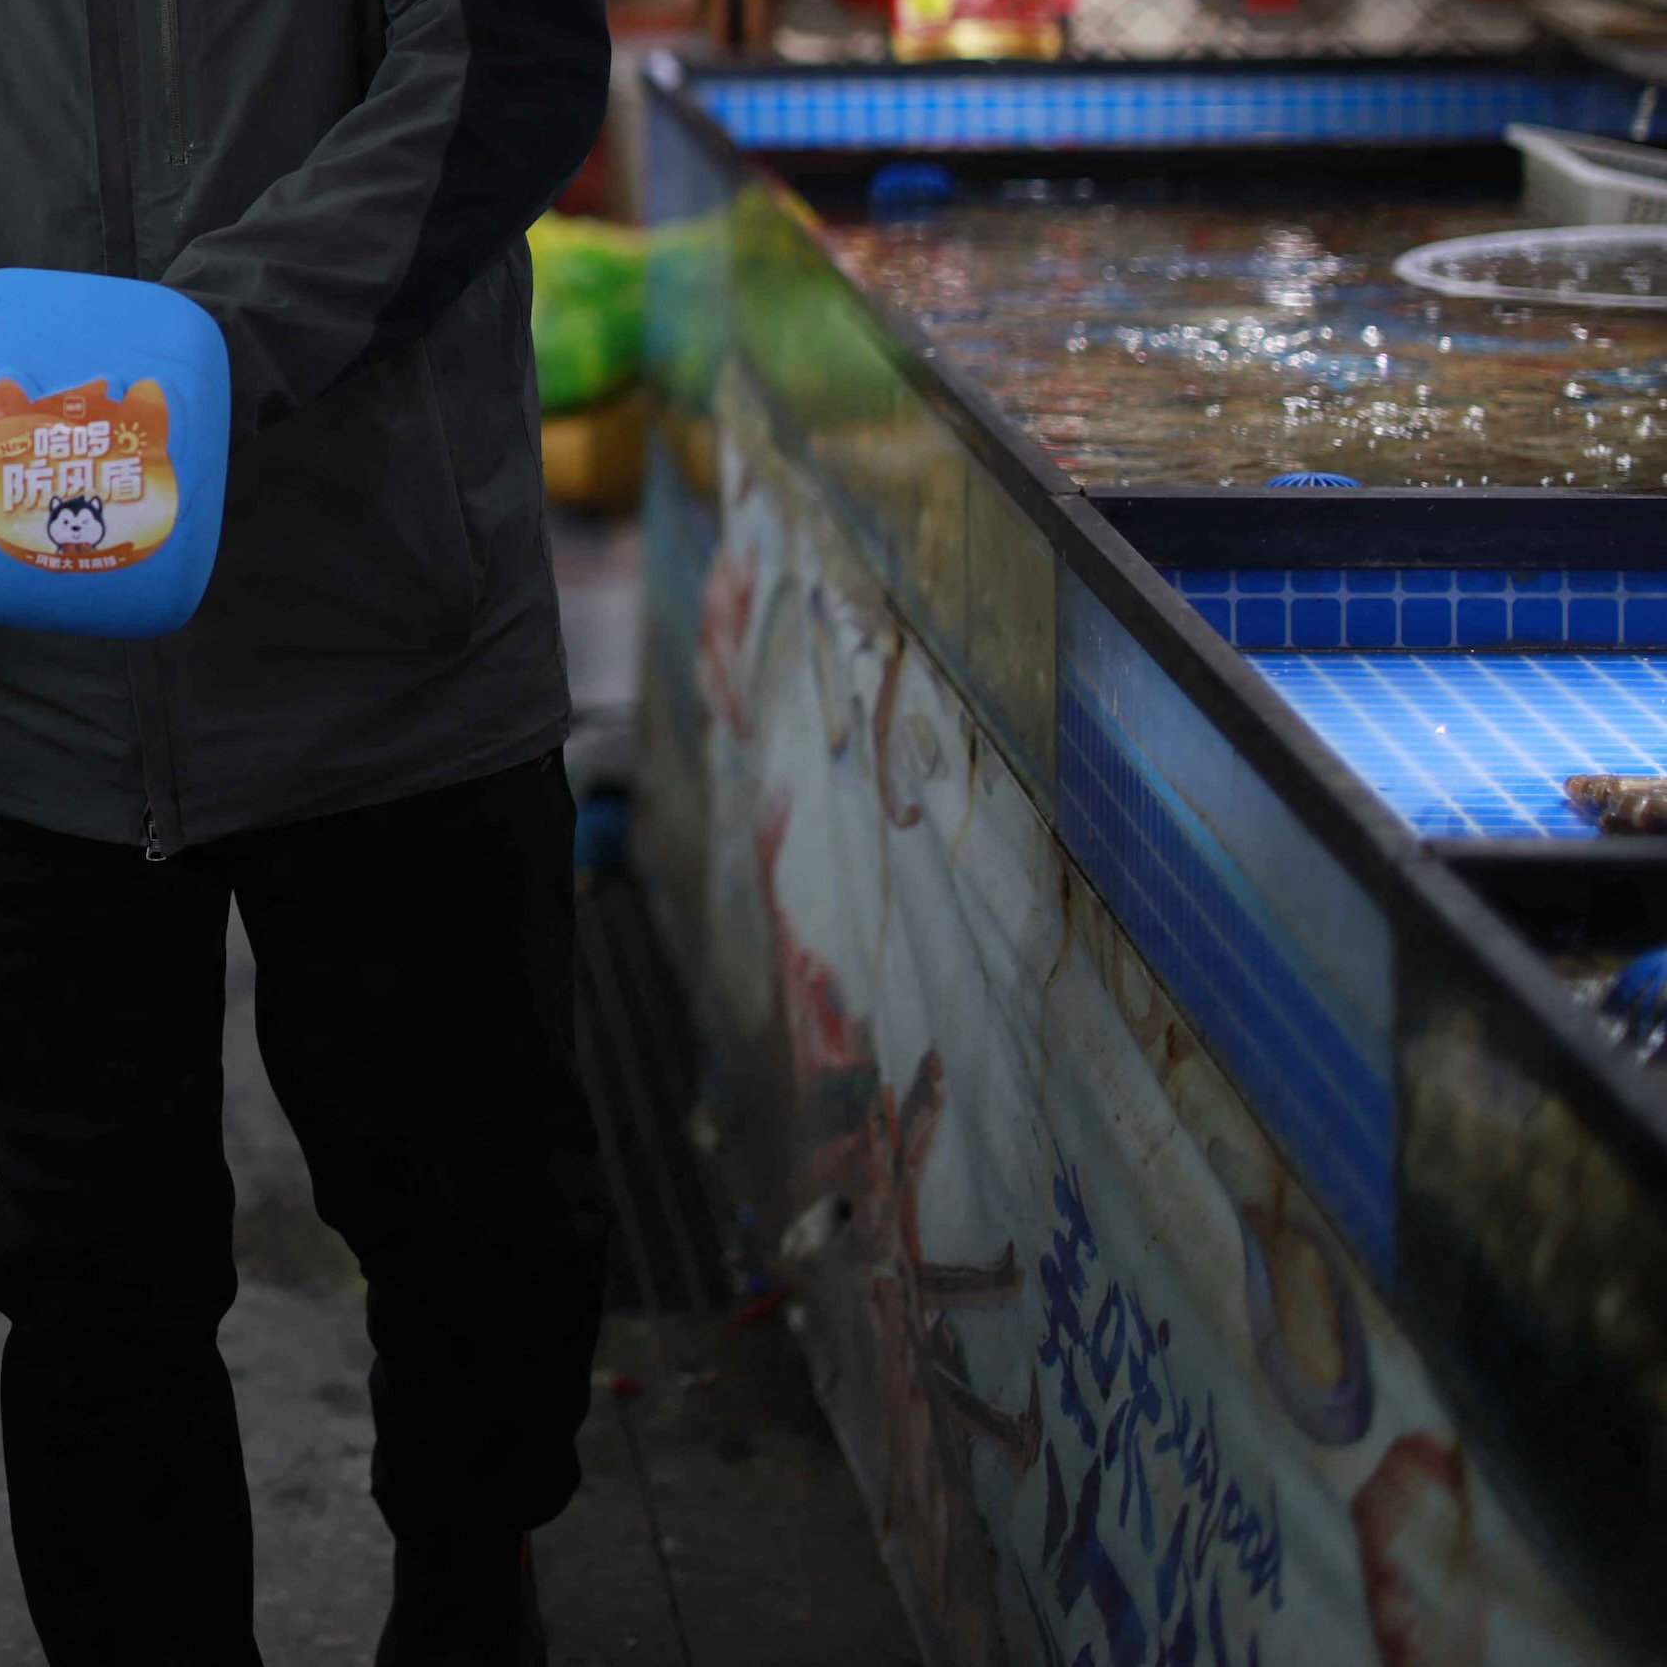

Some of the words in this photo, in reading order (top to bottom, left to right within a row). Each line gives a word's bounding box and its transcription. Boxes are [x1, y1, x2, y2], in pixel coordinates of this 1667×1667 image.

[33, 420, 111, 458] 哈啰
[1, 456, 143, 512] 防风盾
